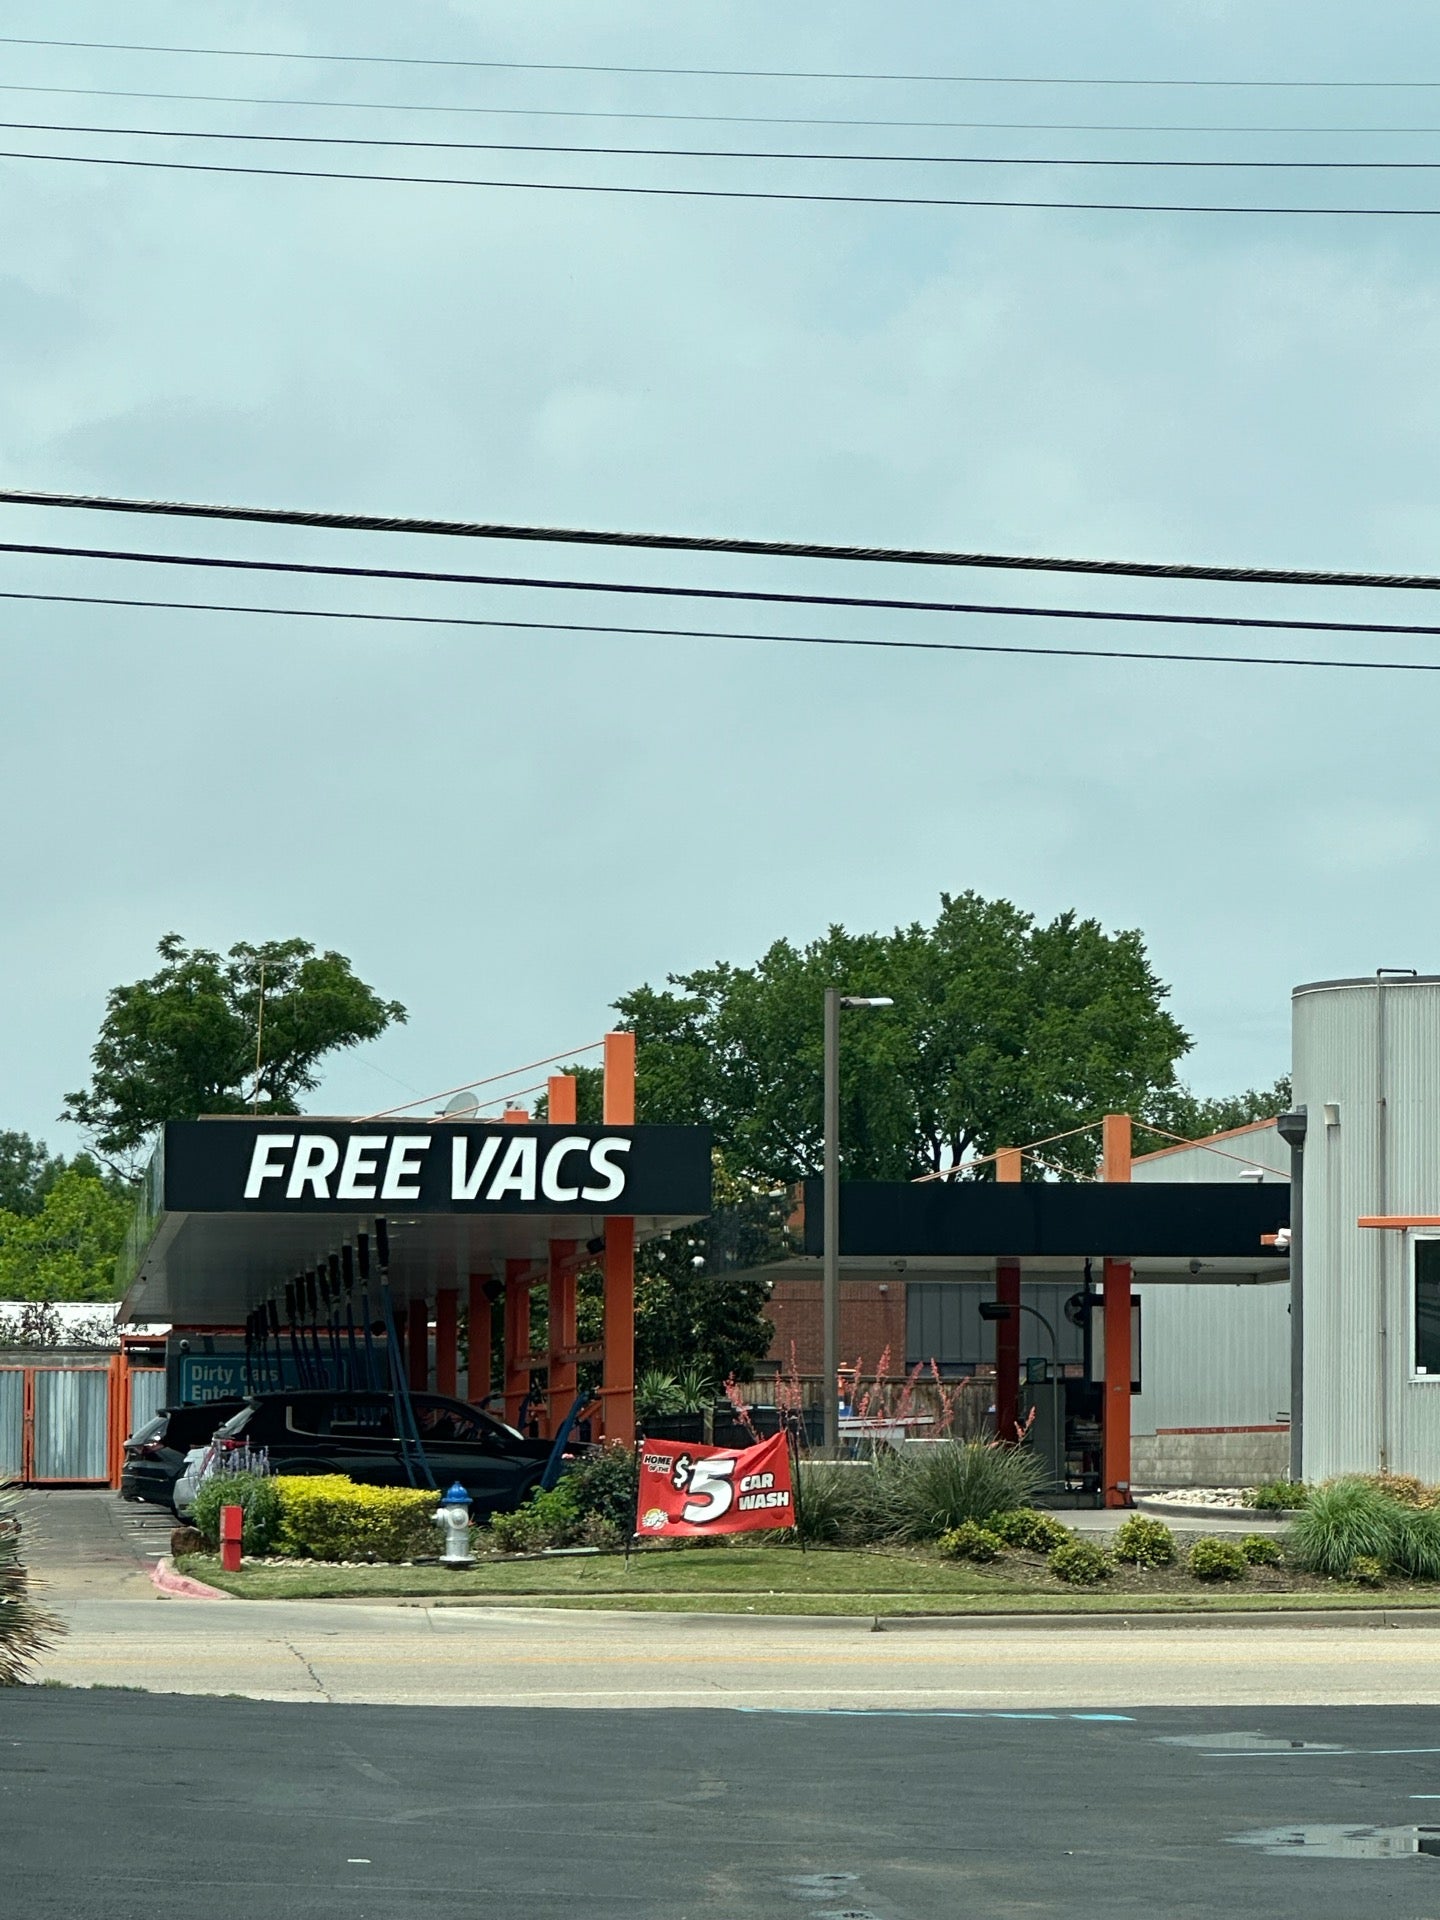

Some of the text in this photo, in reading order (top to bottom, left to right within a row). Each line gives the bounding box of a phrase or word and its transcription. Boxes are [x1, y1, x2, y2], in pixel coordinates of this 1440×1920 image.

[243, 1133, 632, 1202] FREE VACS
[191, 1365, 233, 1384] Dirty
[191, 1385, 238, 1400] Enter
[644, 1455, 672, 1465] HOME
[740, 1473, 773, 1492] CAR
[739, 1491, 790, 1511] WASH
